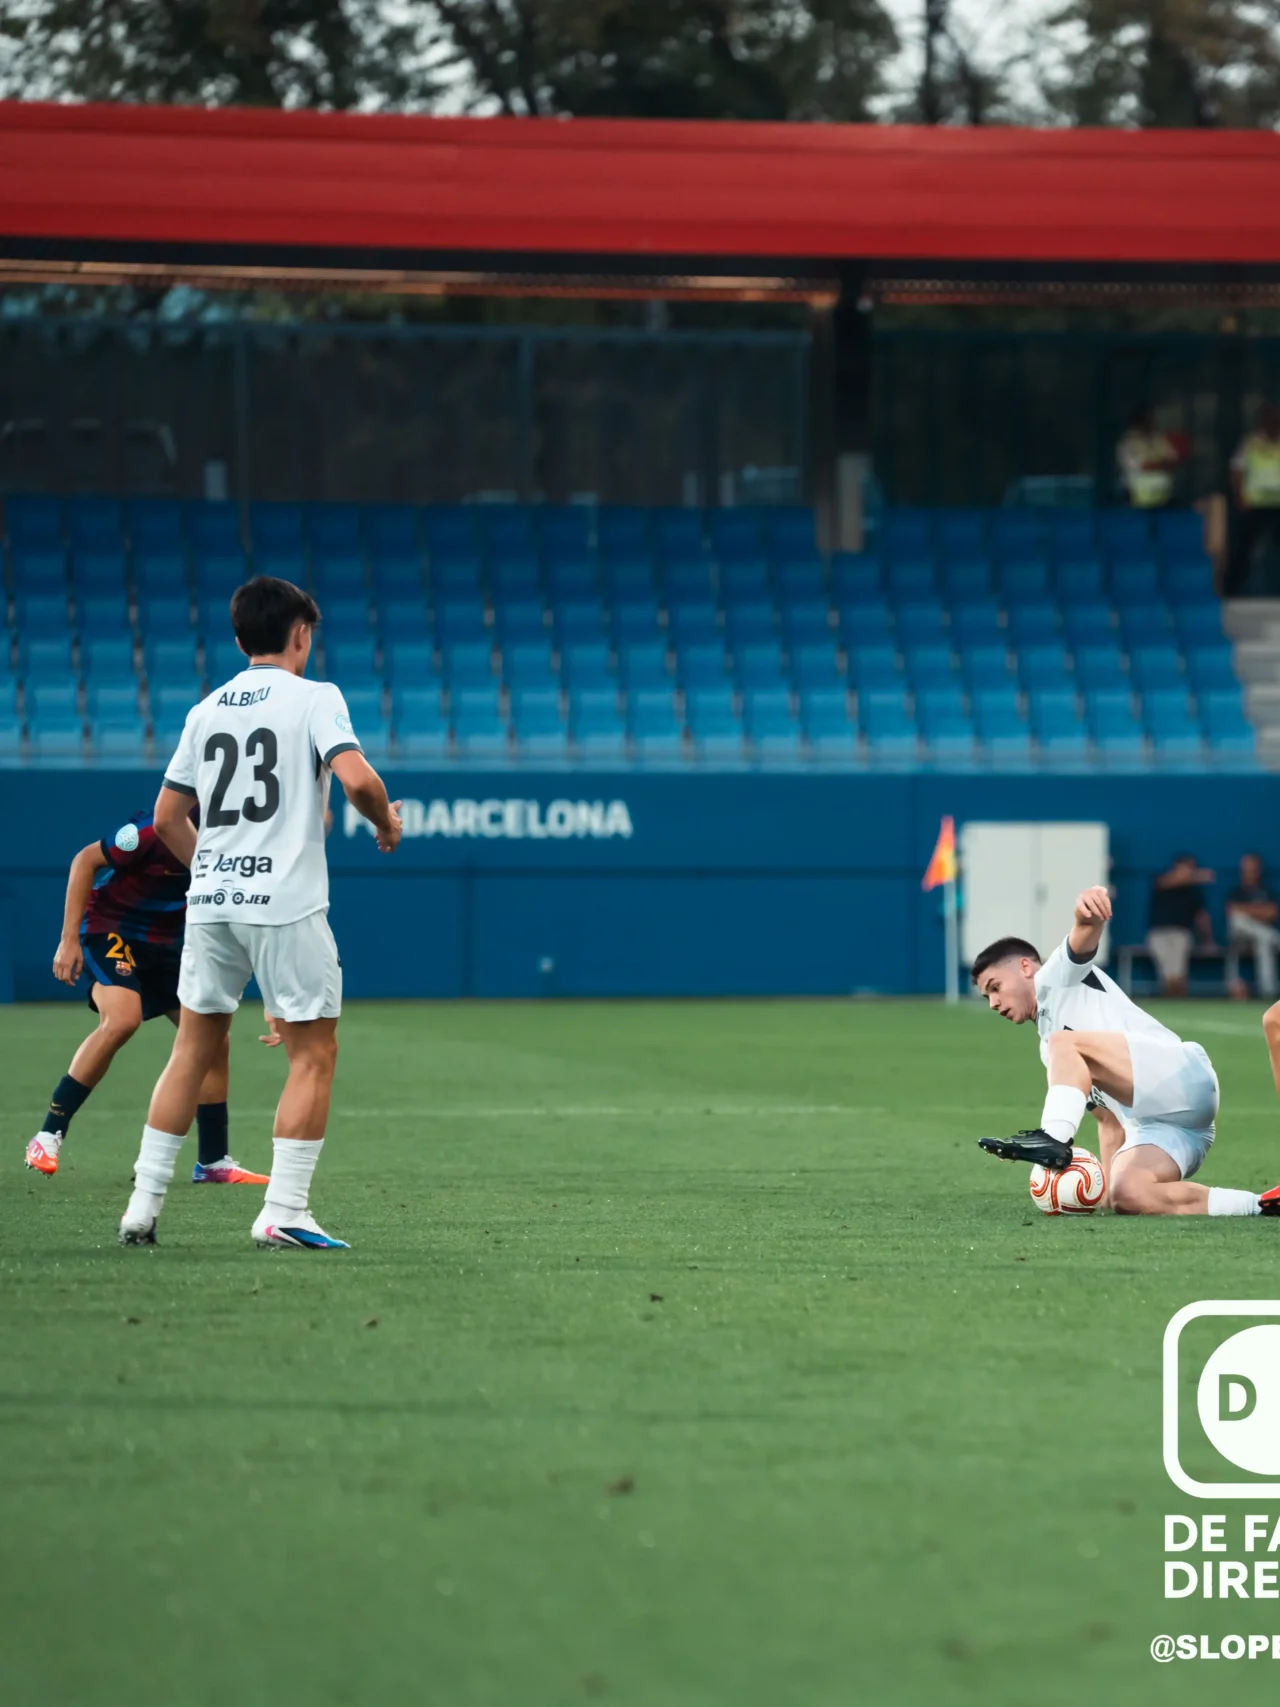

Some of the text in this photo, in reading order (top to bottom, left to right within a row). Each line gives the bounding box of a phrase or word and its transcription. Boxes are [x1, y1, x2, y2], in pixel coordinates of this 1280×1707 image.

[217, 686, 271, 706] ALBIZU
[204, 727, 280, 828] 23
[399, 798, 634, 839] BARCELONA
